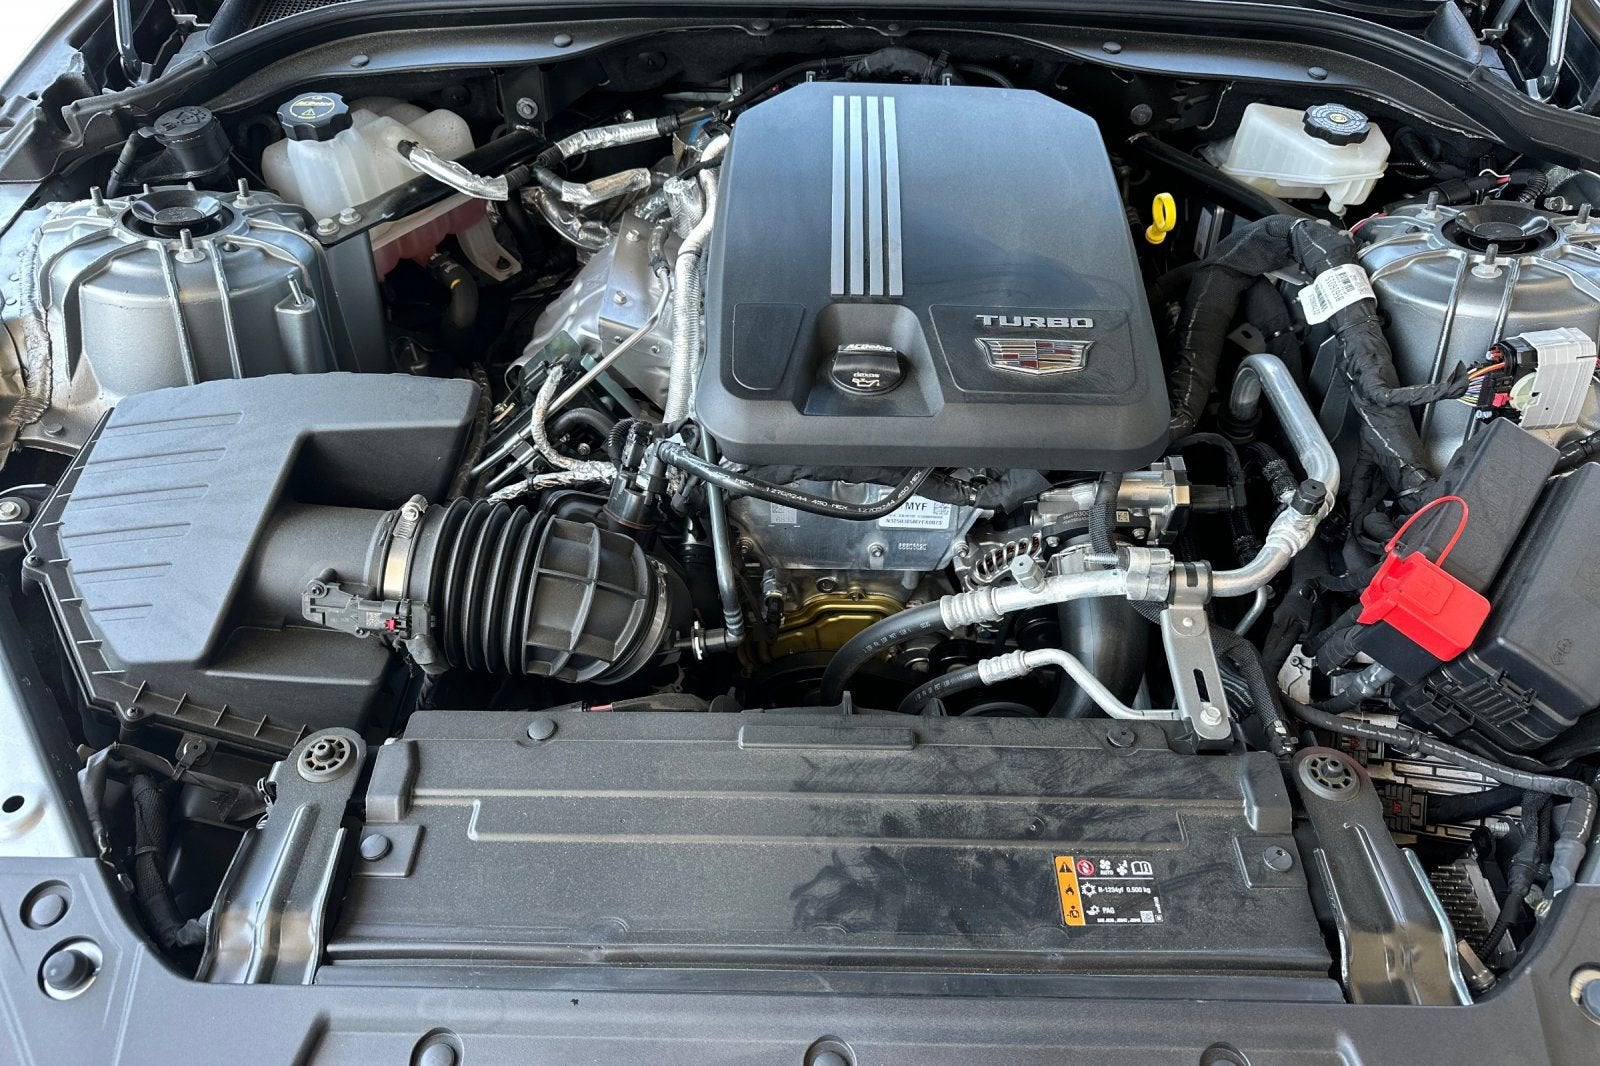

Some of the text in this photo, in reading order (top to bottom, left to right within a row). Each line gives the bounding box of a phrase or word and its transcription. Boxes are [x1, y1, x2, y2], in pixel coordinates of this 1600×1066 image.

[976, 314, 1094, 328] TURBO
[843, 343, 893, 351] ACDelco
[831, 501, 848, 511] MEX
[909, 470, 923, 485] MEX
[905, 501, 928, 511] MYF
[1098, 886, 1124, 894] R-1234yf
[1143, 886, 1151, 894] kg
[1102, 906, 1115, 914] PAG
